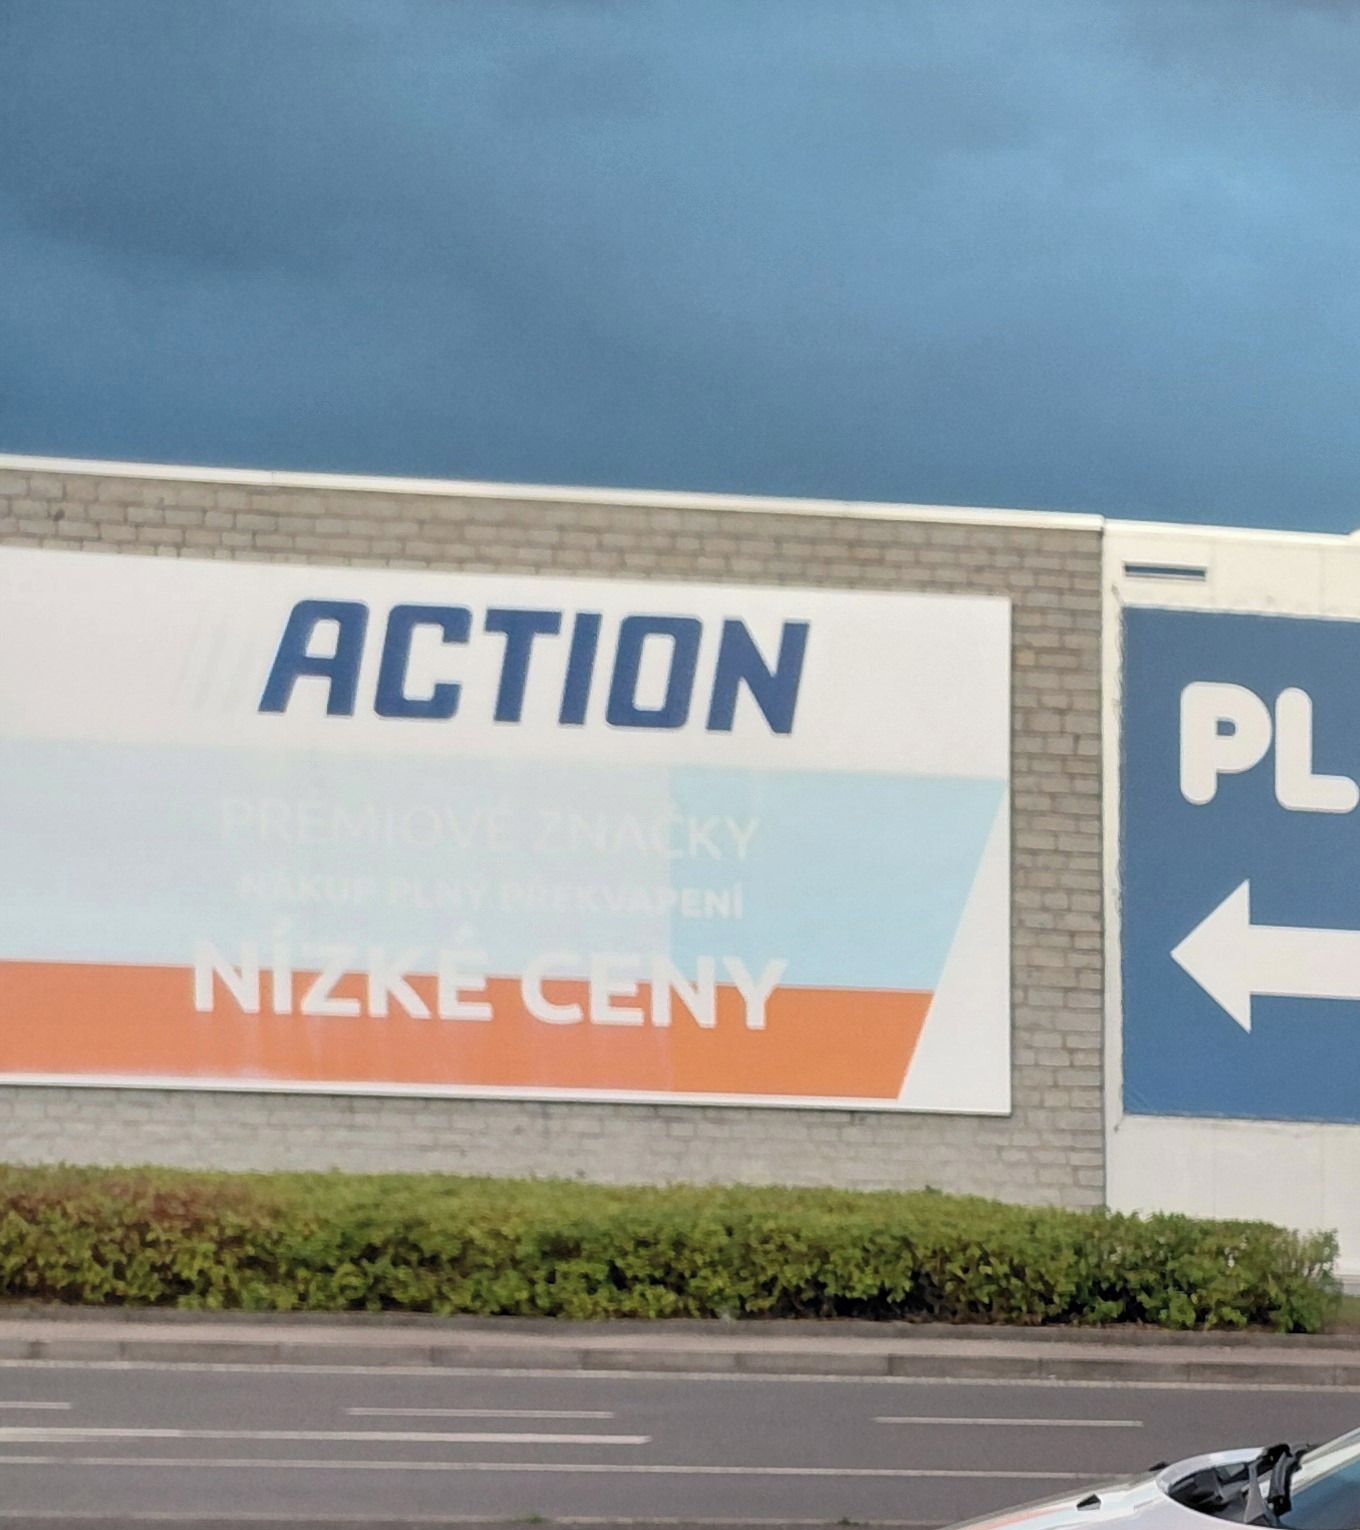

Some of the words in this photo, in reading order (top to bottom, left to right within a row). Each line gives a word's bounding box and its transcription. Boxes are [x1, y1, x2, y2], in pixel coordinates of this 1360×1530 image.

[257, 598, 811, 736] ACTION
[533, 802, 761, 860] ZNAČKY
[193, 917, 494, 1023] NÍZKÉ
[521, 951, 788, 1030] CENY
